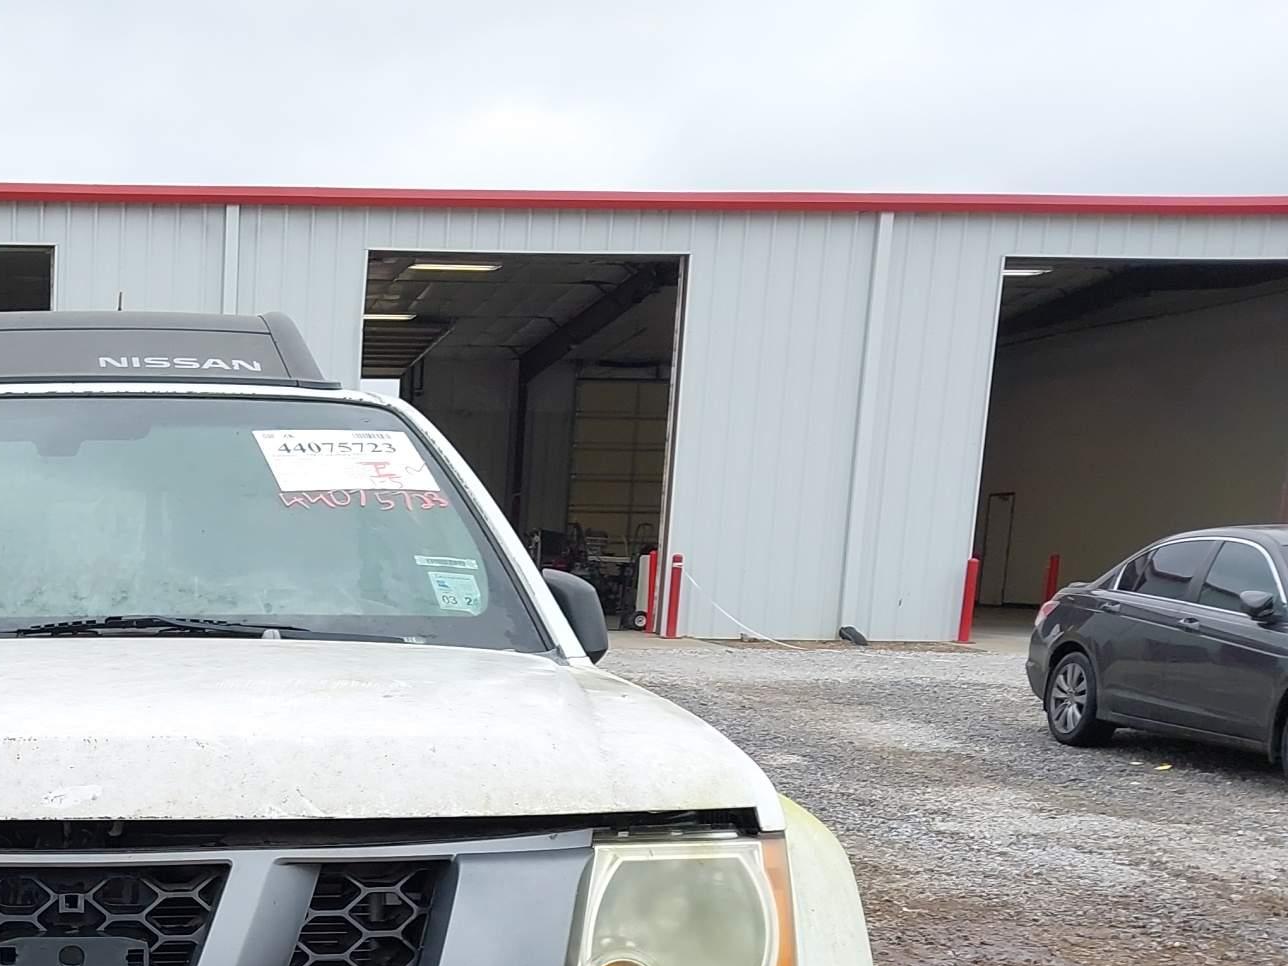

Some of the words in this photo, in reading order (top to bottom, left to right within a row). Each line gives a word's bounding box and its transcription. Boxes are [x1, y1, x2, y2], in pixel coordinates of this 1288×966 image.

[98, 356, 262, 371] NISSAN
[278, 442, 397, 454] 44075723
[441, 595, 458, 604] 03
